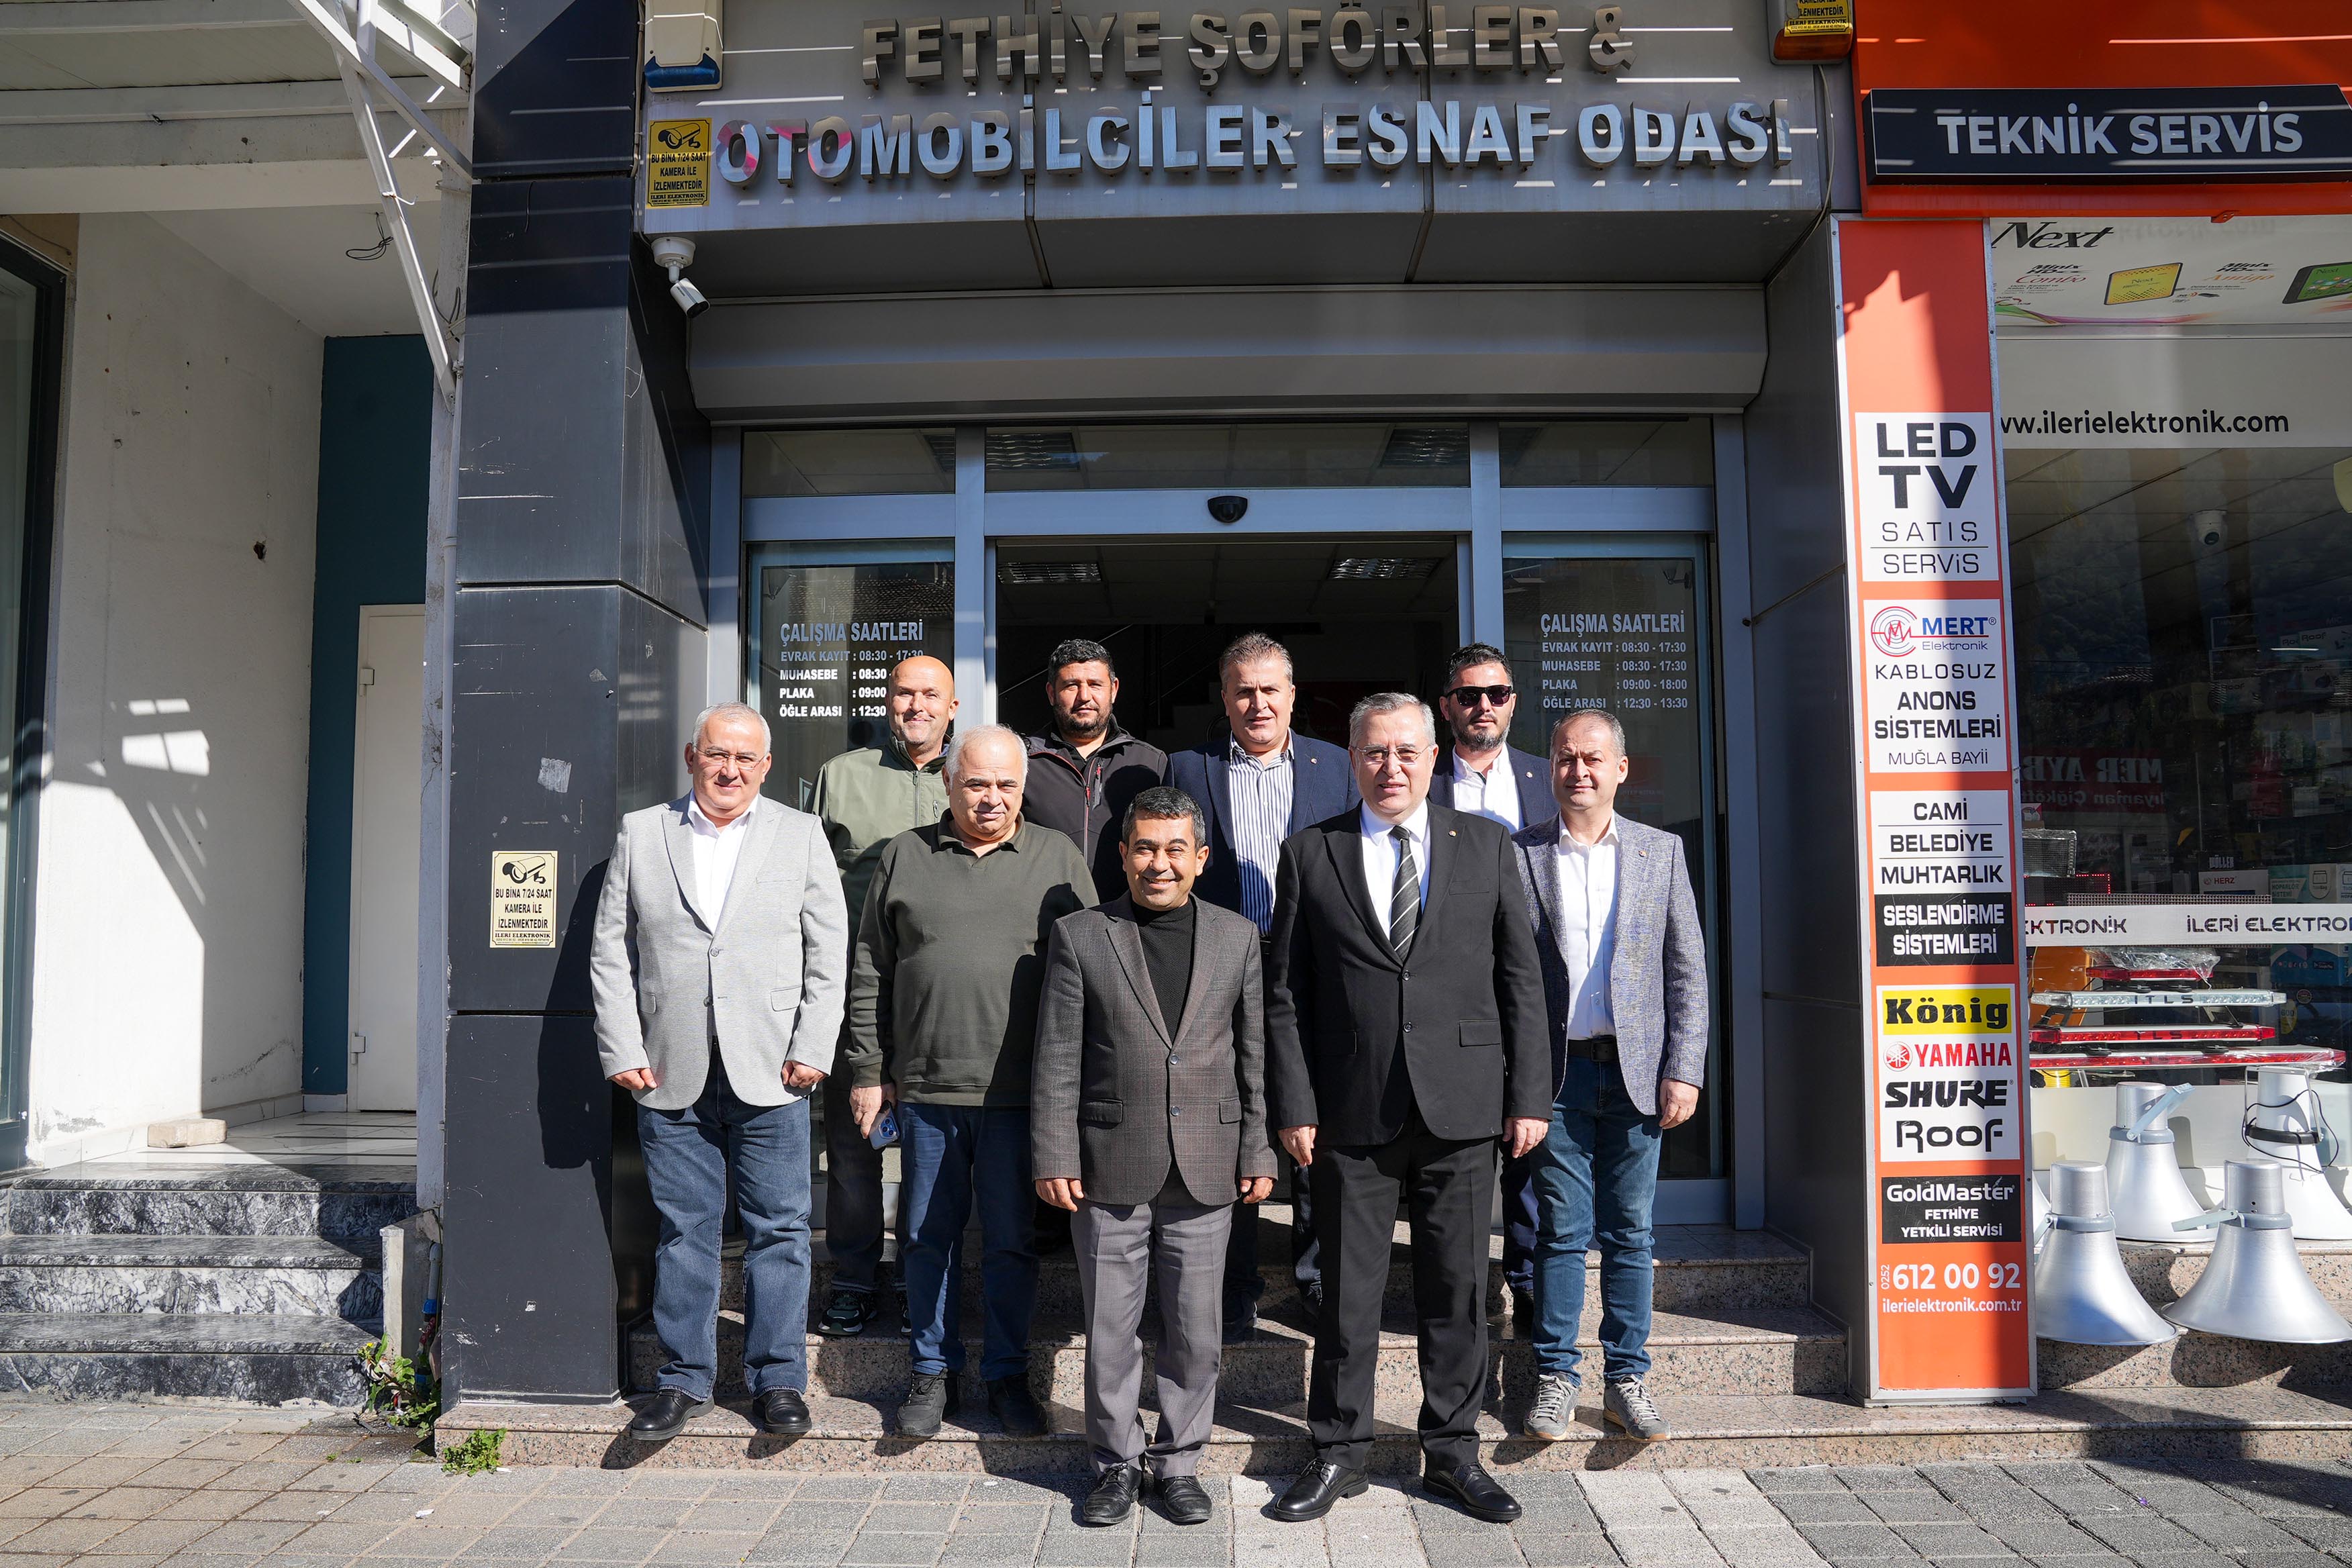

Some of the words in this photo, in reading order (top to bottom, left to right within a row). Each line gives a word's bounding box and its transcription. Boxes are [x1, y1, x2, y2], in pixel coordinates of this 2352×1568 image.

[863, 0, 1162, 85] FETHİYE
[1188, 0, 1565, 91] ŞOFÖRLER
[1589, 5, 1637, 70] &
[1937, 103, 2118, 154] TEKNİK
[2129, 101, 2303, 153] SERVİS
[716, 91, 1297, 187] OTOMOBİLCİLER
[1322, 100, 1551, 172] ESNAF
[1577, 99, 1792, 168] ODASI
[651, 154, 660, 163] BU
[661, 152, 675, 162] BİNA
[677, 153, 689, 162] 7/24
[691, 152, 706, 162] SAAT
[660, 166, 685, 177] KAMERA
[687, 165, 697, 175] İLE
[654, 178, 702, 191] İZLENMEKTEDİR
[1992, 222, 2114, 248] Next
[2016, 275, 2086, 283] Combo
[2203, 273, 2275, 283] Amigo
[1877, 422, 1977, 458] LED
[1878, 465, 1977, 509] TV
[1882, 522, 1977, 542] SATIŞ
[781, 623, 846, 646] ÇALIŞMA
[850, 619, 923, 641] SAATLERİ
[1541, 614, 1608, 638] ÇALIŞMA
[1613, 610, 1685, 633] SAATLERİ
[1542, 642, 1578, 652] EVRAK
[1581, 642, 1613, 652] KAYIT
[1622, 642, 1649, 652] 08:30
[1659, 642, 1686, 652] 17:30
[1922, 641, 1988, 650] Elektronik
[781, 650, 817, 661] EVRAK
[820, 650, 850, 661] KAYIT
[859, 650, 887, 661] 08:30
[780, 669, 838, 680] MUHASEBE
[859, 669, 887, 680] 08:30
[1542, 660, 1600, 671] MUHASEBE
[1622, 660, 1650, 671] 08:30
[1659, 660, 1687, 671] 17:30
[1875, 663, 1996, 679] KABLOSUZ
[780, 688, 814, 698] PLAKA
[859, 687, 887, 698] 09:00
[1542, 679, 1577, 690] PLAKA
[1623, 679, 1651, 690] 09:00
[1660, 679, 1687, 690] 18:00
[1543, 695, 1571, 709] ÖĞLE
[1574, 698, 1606, 708] ARASI
[1623, 698, 1651, 709] 12:30
[1661, 697, 1687, 709] 13:30
[1897, 691, 1976, 710] ANONS
[779, 704, 807, 717] ÖĞLE
[810, 706, 842, 716] ARASI
[859, 705, 887, 716] 12:30
[1874, 714, 2001, 739] SİSTEMLERİ
[1889, 748, 1947, 765] MUĞLA
[1914, 797, 1967, 820] CAMİ
[1890, 829, 1993, 852] BELEDİYE
[1881, 865, 2004, 884] MUHTARLIK
[496, 889, 503, 898] BU
[506, 887, 520, 898] BİNA
[523, 889, 534, 898] 7/24
[536, 889, 552, 899] SAAT
[505, 903, 530, 914] KAMERA
[532, 901, 542, 913] İLE
[1883, 899, 2004, 926] SESLENDİRME
[498, 917, 548, 928] İZLENMEKTEDİR
[2025, 916, 2126, 934] KTRONİK
[2187, 914, 2239, 932] İLERİ
[2245, 917, 2352, 932] ELEKTRO
[1893, 928, 1997, 955] SİSTEMLERİ
[1885, 997, 2008, 1029] König
[1914, 1042, 2012, 1067] YAMAHA
[1885, 1079, 2008, 1109] SHURE
[1887, 1183, 2013, 1202] GoldMaster
[1925, 1206, 1979, 1220] FETHİYE
[1901, 1224, 1950, 1237] YETKİLİ
[1953, 1223, 2002, 1236] SERVİSİ
[1880, 1265, 1890, 1289] 0252
[1893, 1263, 1936, 1289] 612
[1944, 1263, 1979, 1289] 00
[1987, 1263, 2020, 1289] 92
[1882, 1297, 2022, 1313] ilerielektronik.com.tr
